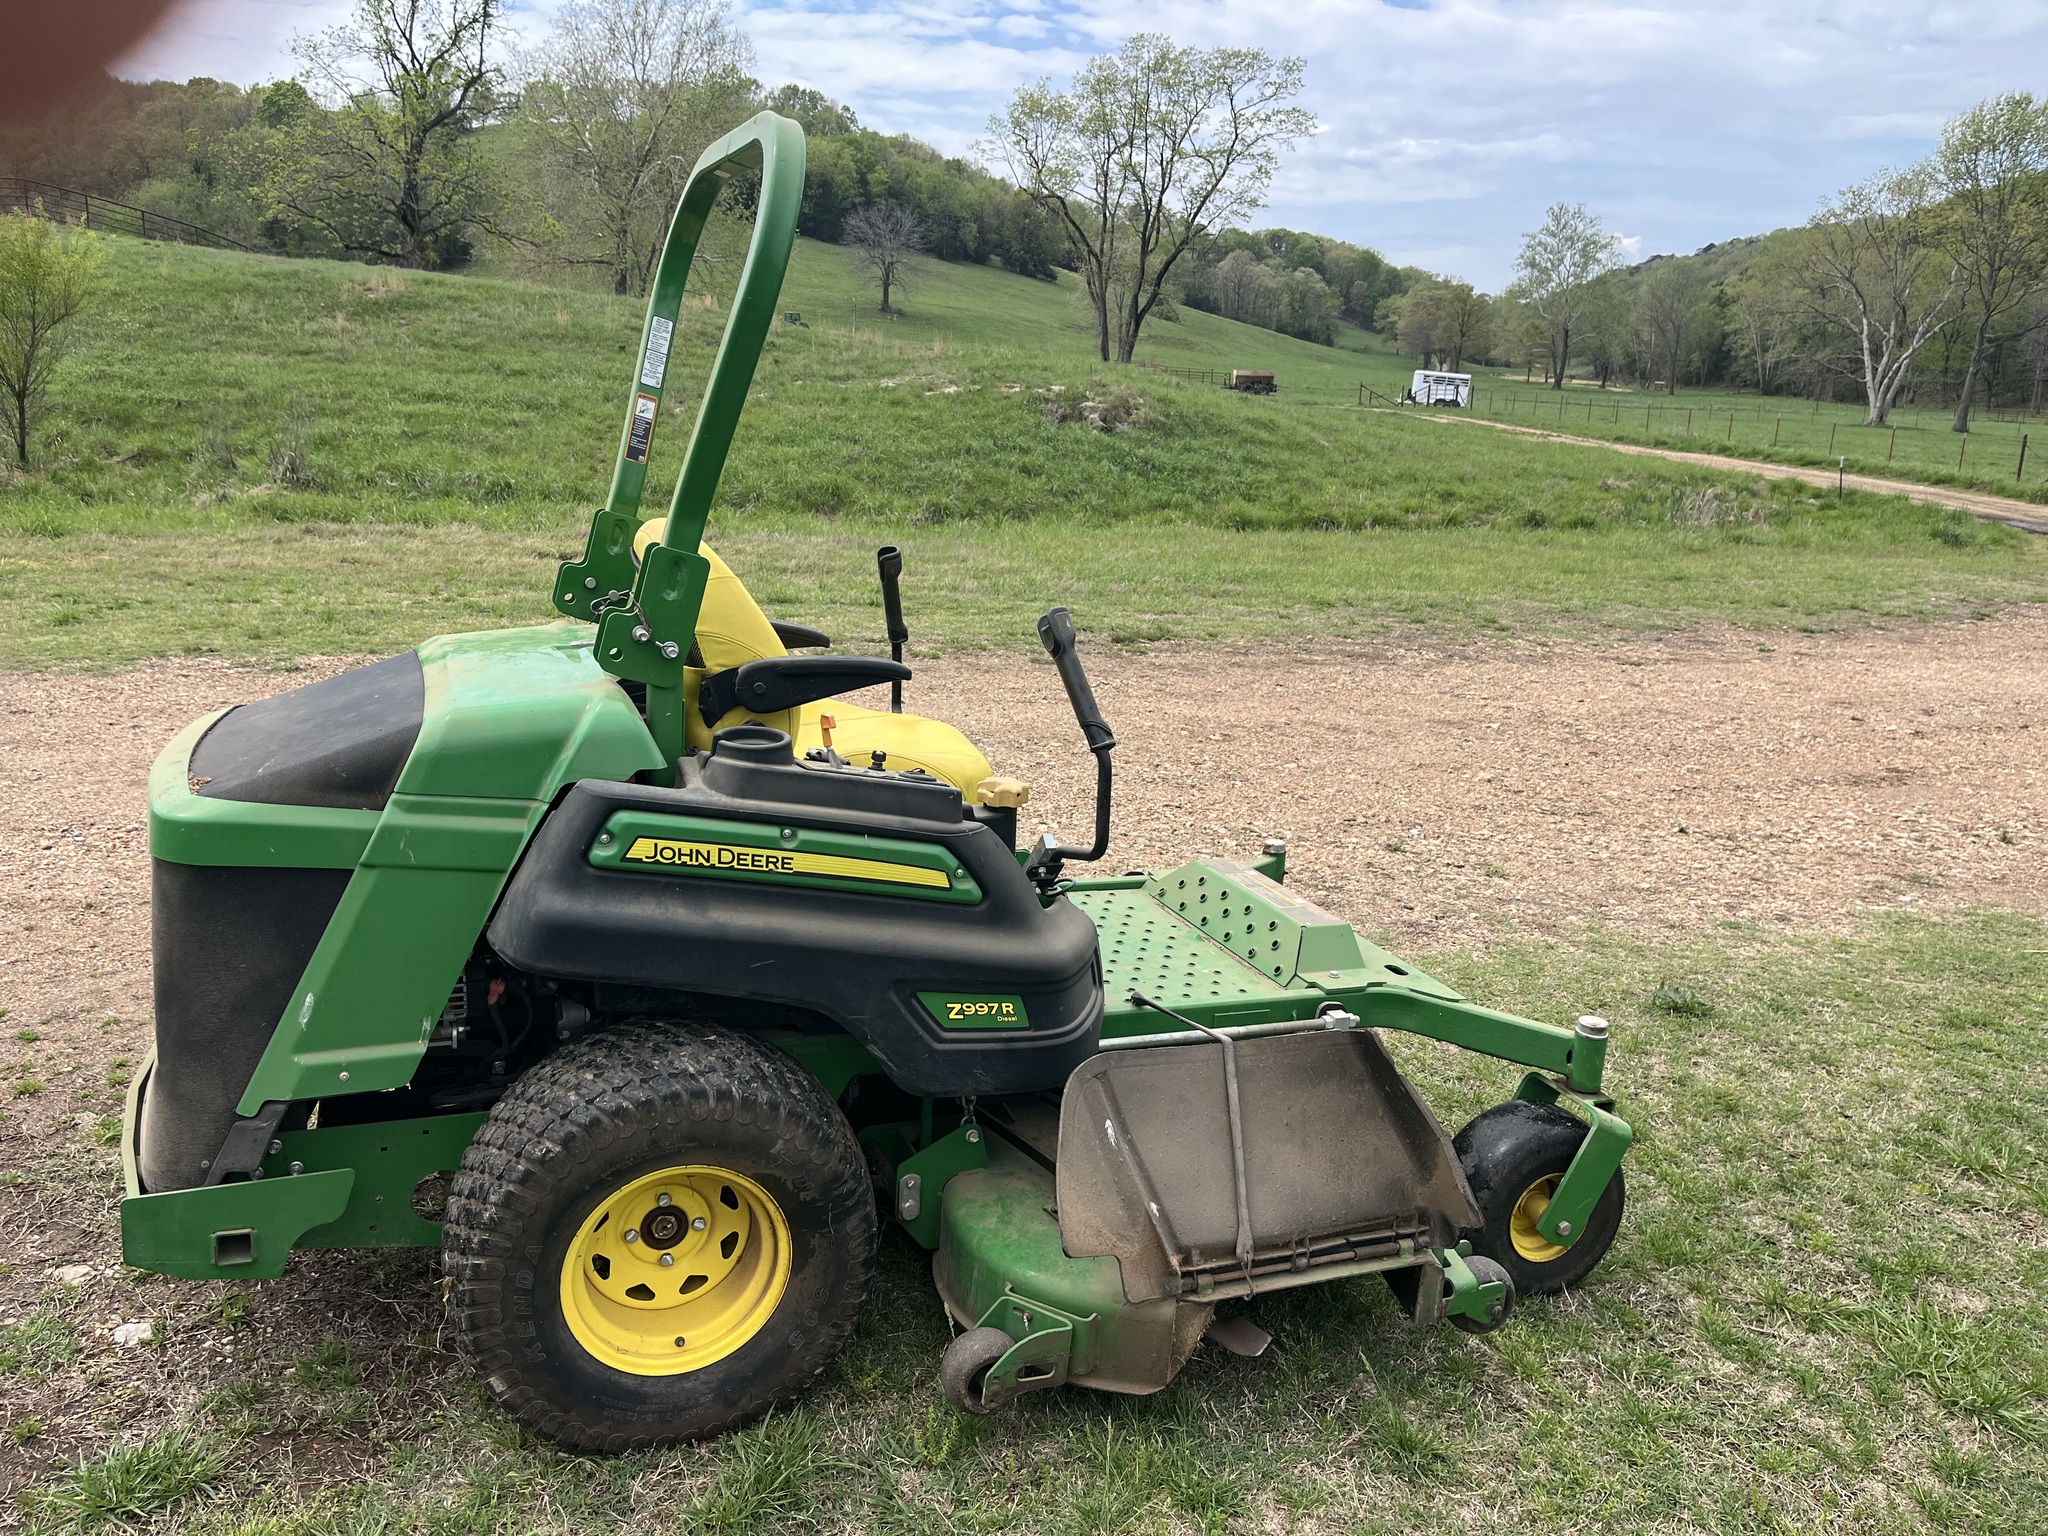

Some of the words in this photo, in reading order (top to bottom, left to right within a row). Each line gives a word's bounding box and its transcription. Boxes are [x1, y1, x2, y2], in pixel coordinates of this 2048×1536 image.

[644, 842, 711, 864] JOHN
[717, 847, 794, 871] DEERE
[513, 1245, 547, 1363] KENDA
